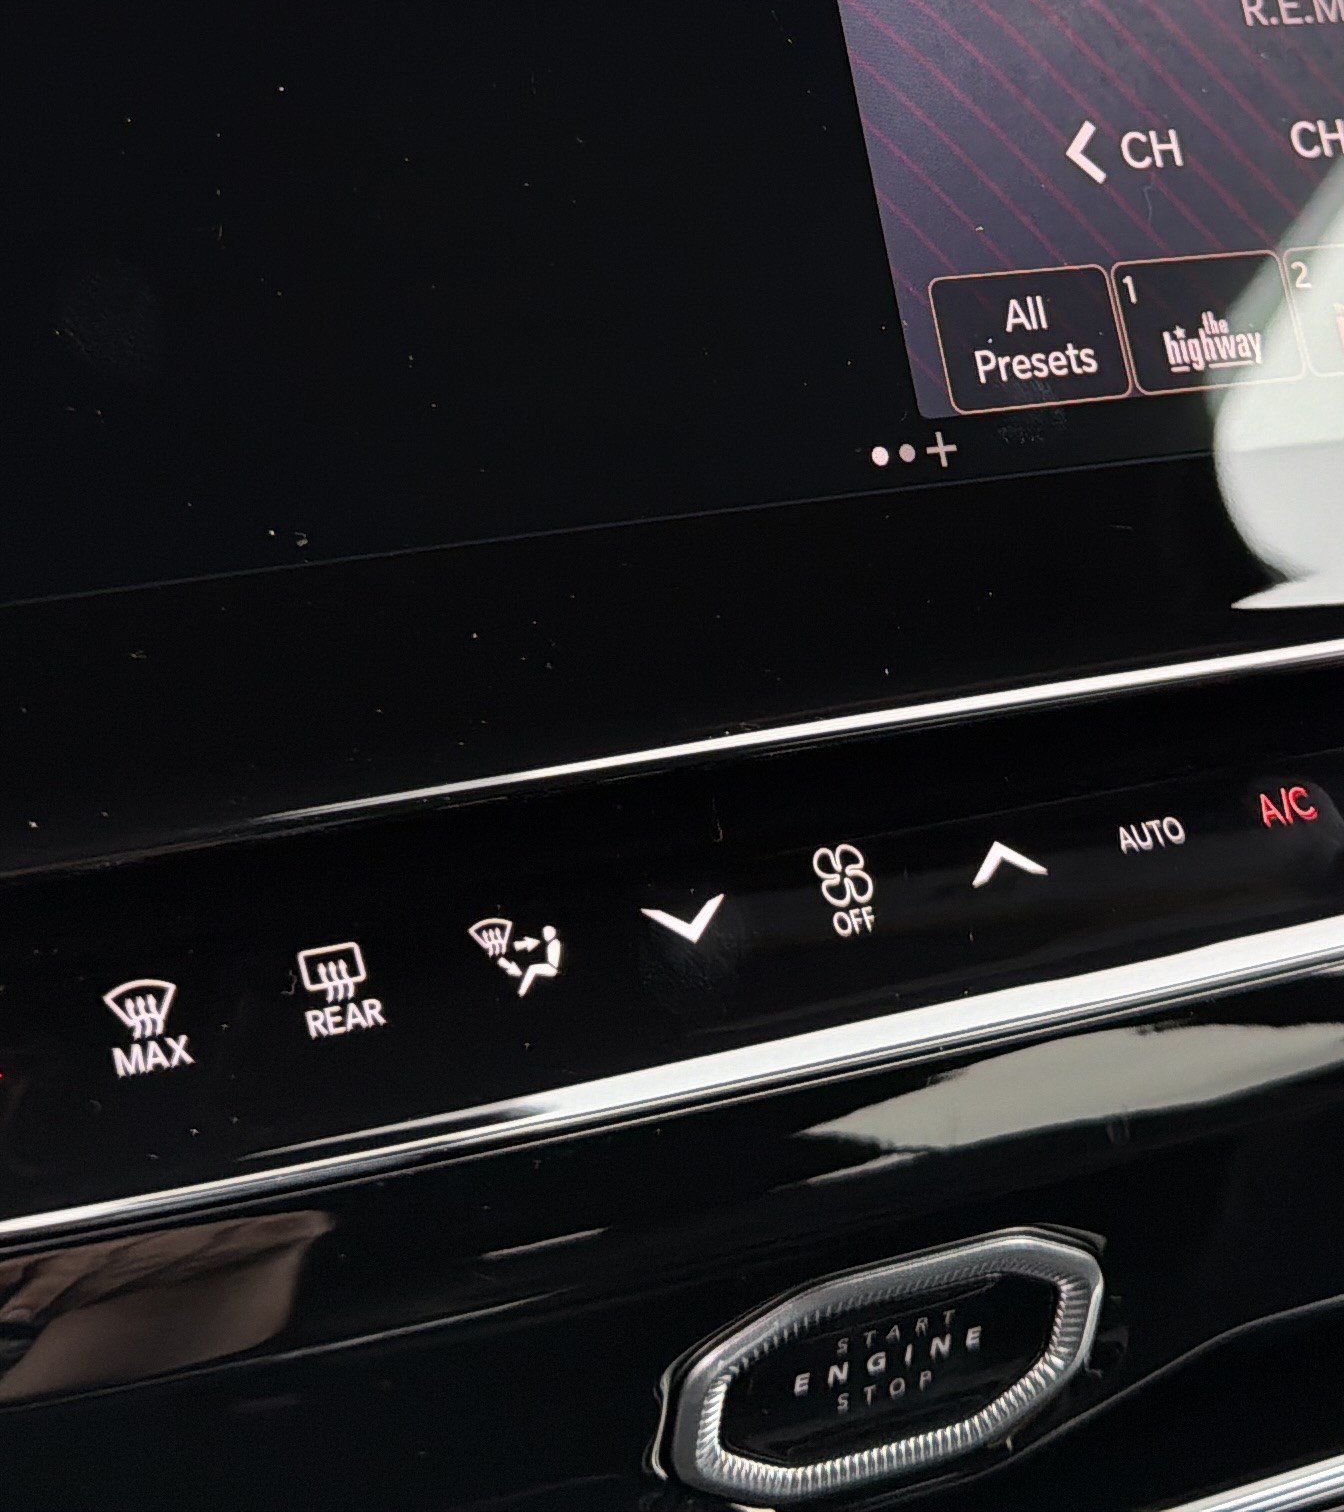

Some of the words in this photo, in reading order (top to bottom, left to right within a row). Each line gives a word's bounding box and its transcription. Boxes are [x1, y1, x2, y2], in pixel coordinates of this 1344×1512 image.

[1120, 128, 1184, 169] CH
[1122, 275, 1138, 305] 1
[1290, 261, 1312, 289] 2
[1005, 295, 1048, 333] All
[1201, 310, 1229, 335] the
[974, 342, 1098, 384] Presets
[1162, 328, 1264, 372] highway
[1259, 786, 1318, 827] A/C
[1119, 816, 1186, 853] AUTO
[831, 905, 875, 937] OFF
[304, 997, 387, 1038] REAR
[112, 1034, 195, 1078] MAX
[837, 1309, 956, 1358] START
[794, 1325, 982, 1398] ENGINE
[837, 1370, 932, 1414] STOP
